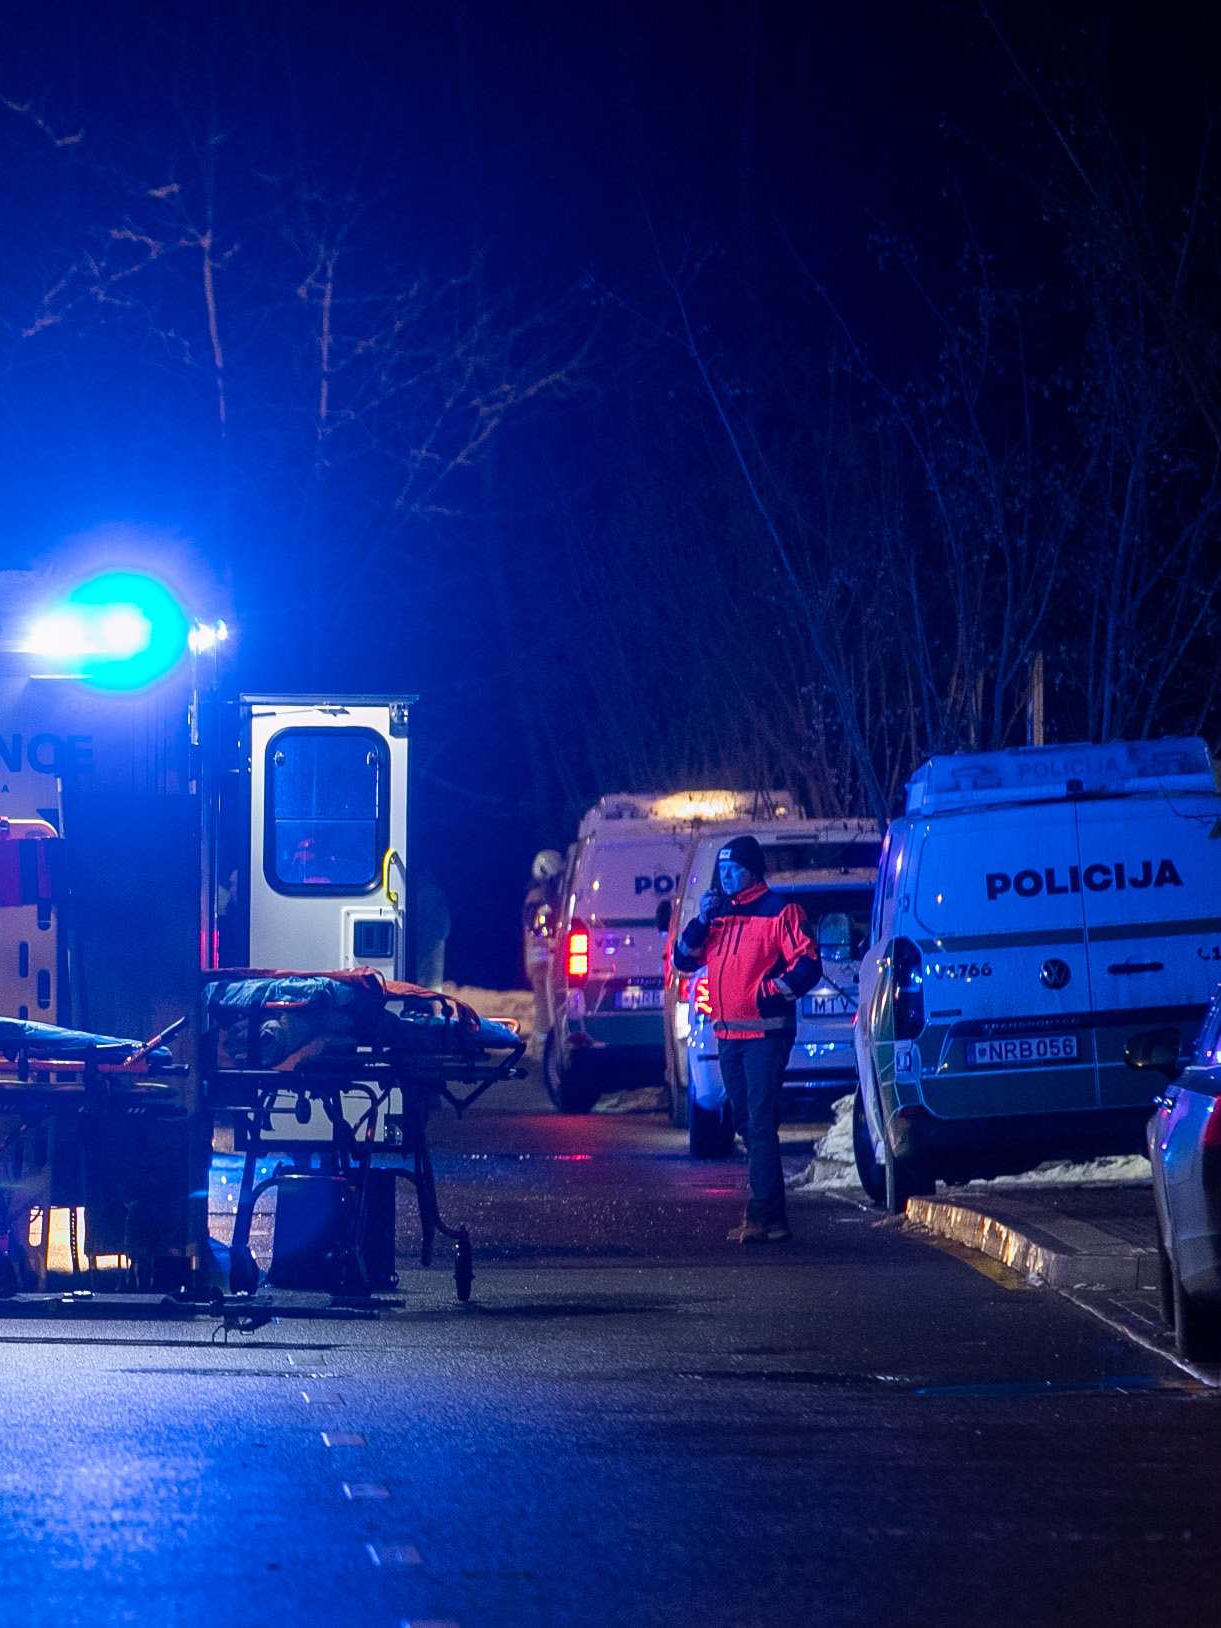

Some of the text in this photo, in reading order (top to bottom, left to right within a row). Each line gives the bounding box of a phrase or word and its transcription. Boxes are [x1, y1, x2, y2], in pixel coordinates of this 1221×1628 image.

[1019, 755, 1120, 780] POLICIJA
[985, 858, 1184, 901] POLICIJA
[988, 1038, 1074, 1061] NRB 056
